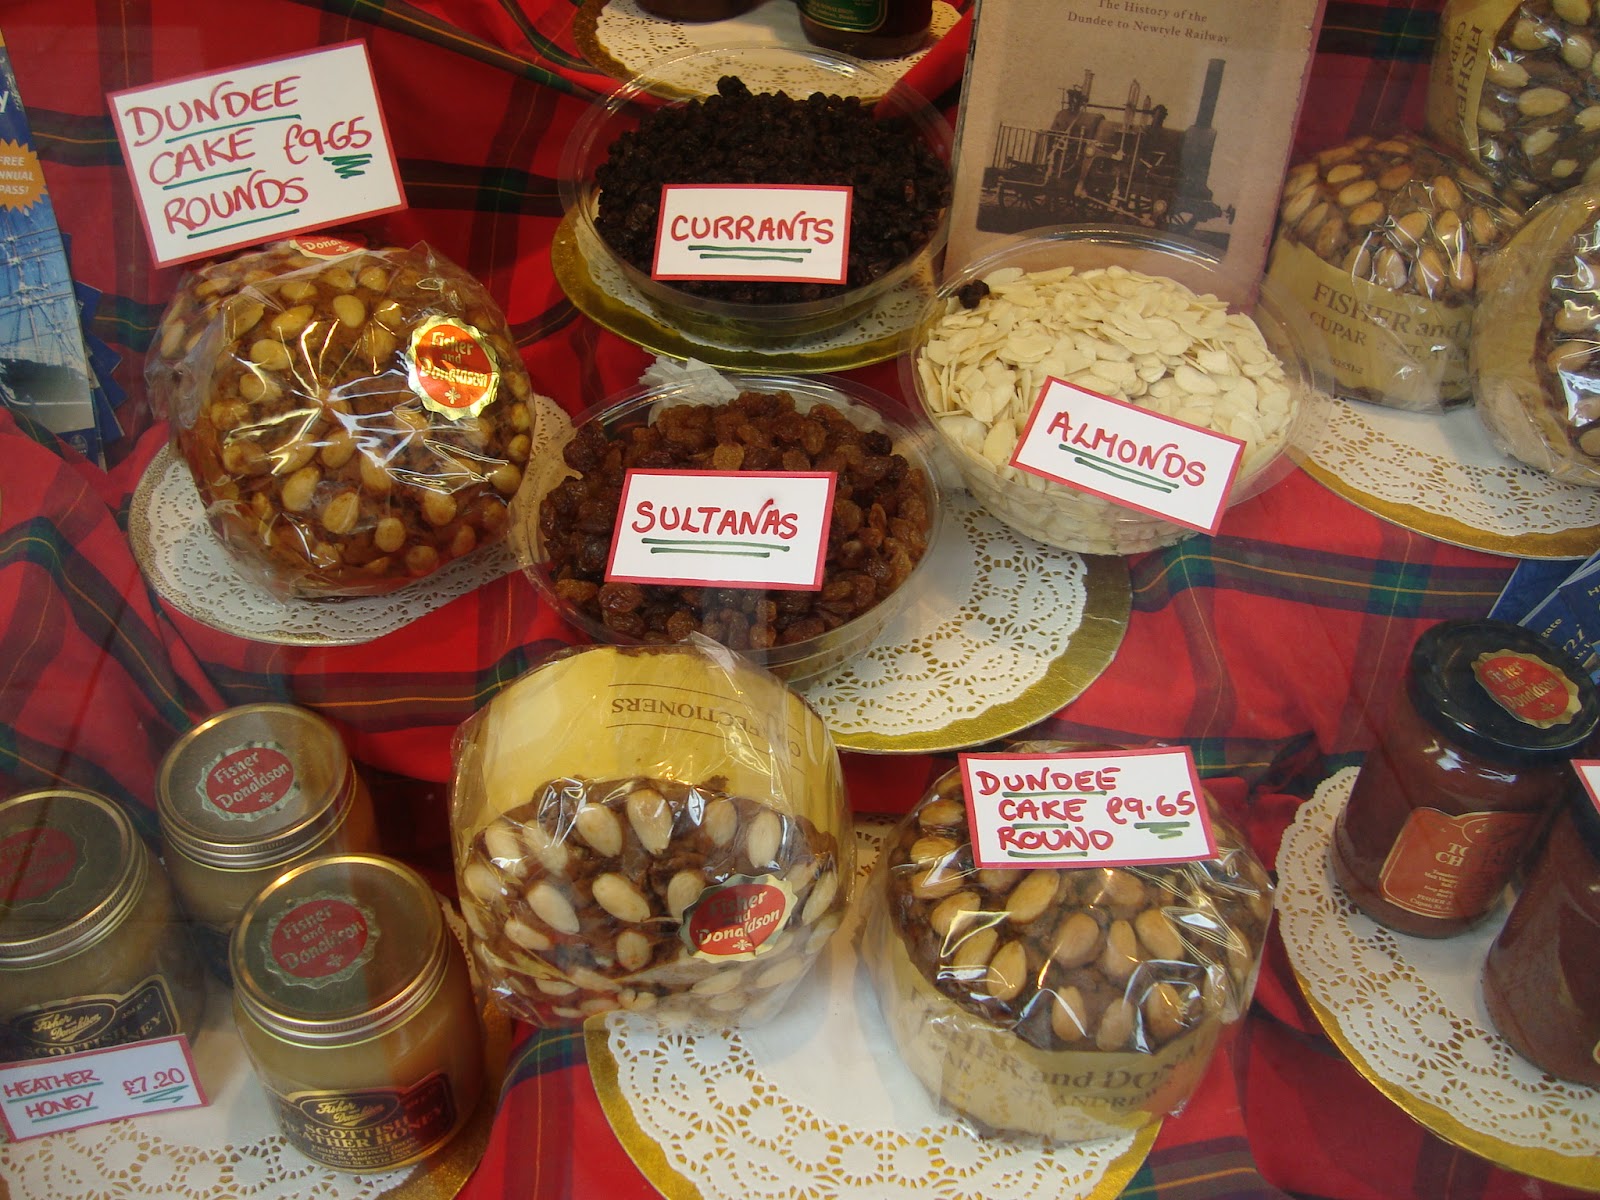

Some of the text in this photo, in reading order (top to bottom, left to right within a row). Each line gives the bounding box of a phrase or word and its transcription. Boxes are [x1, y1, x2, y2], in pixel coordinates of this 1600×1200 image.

[1067, 11, 1232, 46] Dundee to Newtyle Railway
[1098, 0, 1208, 23] The History of the
[1456, 23, 1484, 120] FISHE
[125, 75, 302, 147] DUNDEE
[149, 127, 256, 185] CAKE
[0, 170, 34, 181] NNUAL
[163, 169, 309, 234] ROUNDS
[670, 210, 834, 245] CURRANTS
[1312, 280, 1412, 334] FISHER
[1309, 311, 1367, 347] CUPAR
[1046, 411, 1207, 487] ALMONDS
[631, 498, 799, 540] SULTANAS
[213, 751, 260, 784] Fisher
[232, 768, 256, 786] and
[975, 767, 1121, 795] DUNDEE
[215, 763, 290, 809] Donaldson
[998, 798, 1087, 822] CAKE
[997, 826, 1114, 851] ROUND
[709, 890, 768, 916] Fisher
[281, 905, 333, 940] Fisher
[696, 909, 780, 945] Donaldson
[281, 921, 365, 969] Donaldson
[3, 1067, 186, 1098] HEATHER £7.20
[25, 1091, 95, 1118] HONEY
[303, 1115, 409, 1139] SCOTTISH
